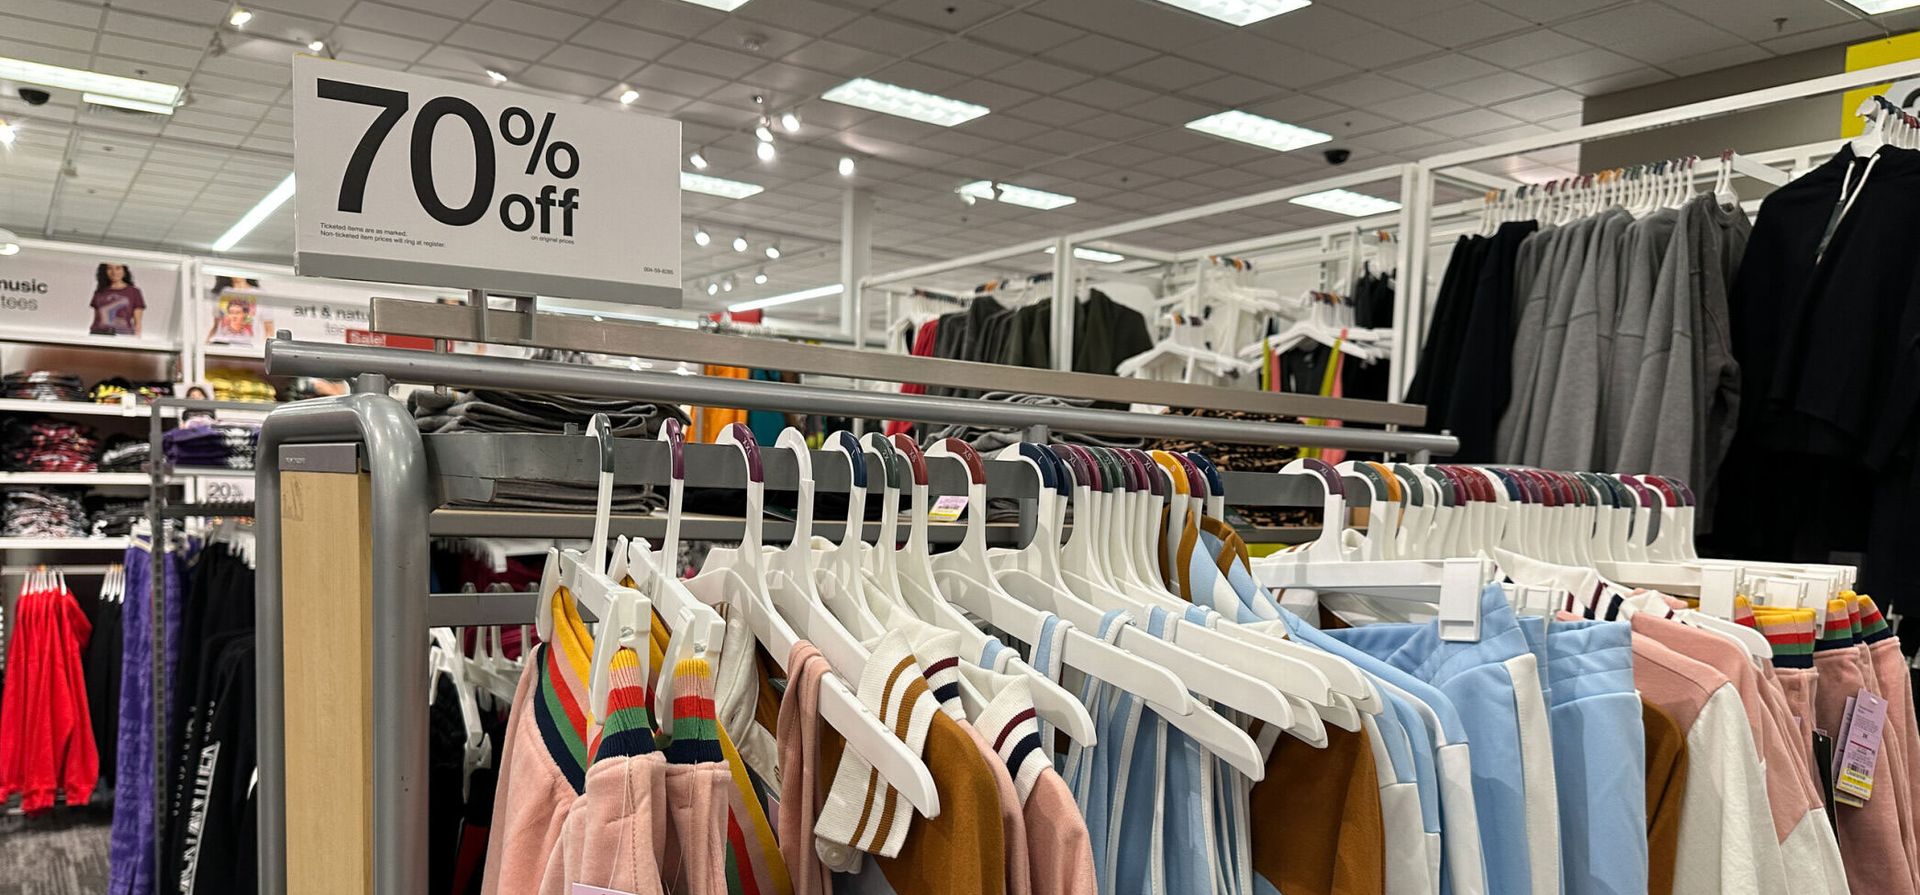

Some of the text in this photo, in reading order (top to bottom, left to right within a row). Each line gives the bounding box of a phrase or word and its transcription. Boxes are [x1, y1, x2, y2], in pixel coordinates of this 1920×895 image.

[499, 185, 580, 236] off
[320, 222, 346, 231] Ticketed
[347, 225, 364, 233] items
[384, 229, 408, 237] marked.
[320, 230, 359, 240] Non-ticketed
[360, 232, 373, 241] item
[374, 235, 392, 243] prices
[404, 238, 415, 246] ring
[539, 235, 558, 243] original
[1, 295, 39, 311] tees
[294, 305, 369, 320] art & natu
[962, 448, 972, 461] XS
[1068, 454, 1077, 467] XL
[1143, 460, 1152, 471] XL
[1204, 465, 1210, 474] L
[1319, 466, 1329, 477] XL
